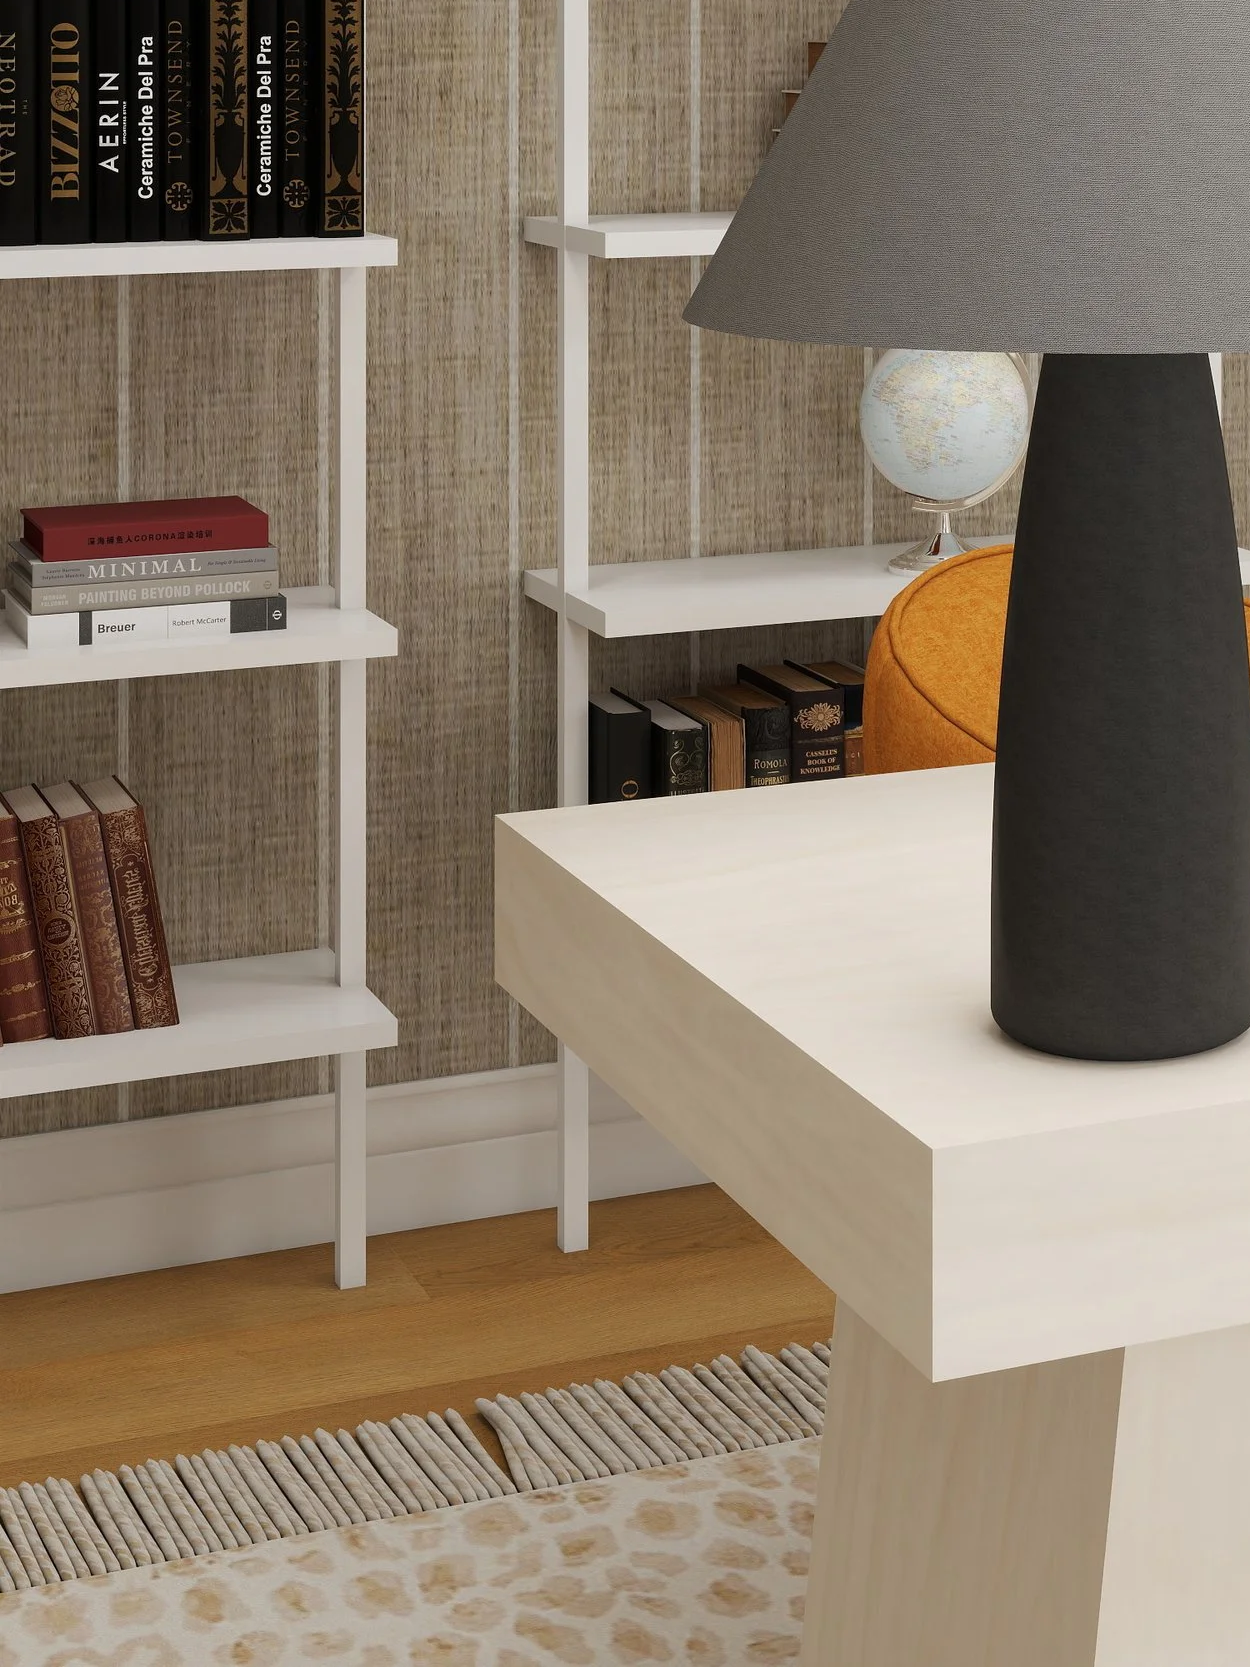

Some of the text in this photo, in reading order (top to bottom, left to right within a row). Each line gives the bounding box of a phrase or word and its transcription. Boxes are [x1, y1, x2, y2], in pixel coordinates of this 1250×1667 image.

[167, 20, 183, 164] TOWNSEND
[285, 20, 300, 161] TOWNSEND
[99, 73, 120, 173] AERIN
[138, 36, 153, 199] Ceramiche Del Pra
[256, 36, 272, 196] Ceramiche Del Pra
[88, 557, 202, 579] MINIMAL
[78, 580, 250, 605] PAINTING BEYOND POLLOCK
[97, 622, 136, 634] Breuer
[172, 616, 227, 627] Robert McCarter
[800, 765, 840, 775] KNOWLEDGE
[807, 758, 826, 766] BOOK
